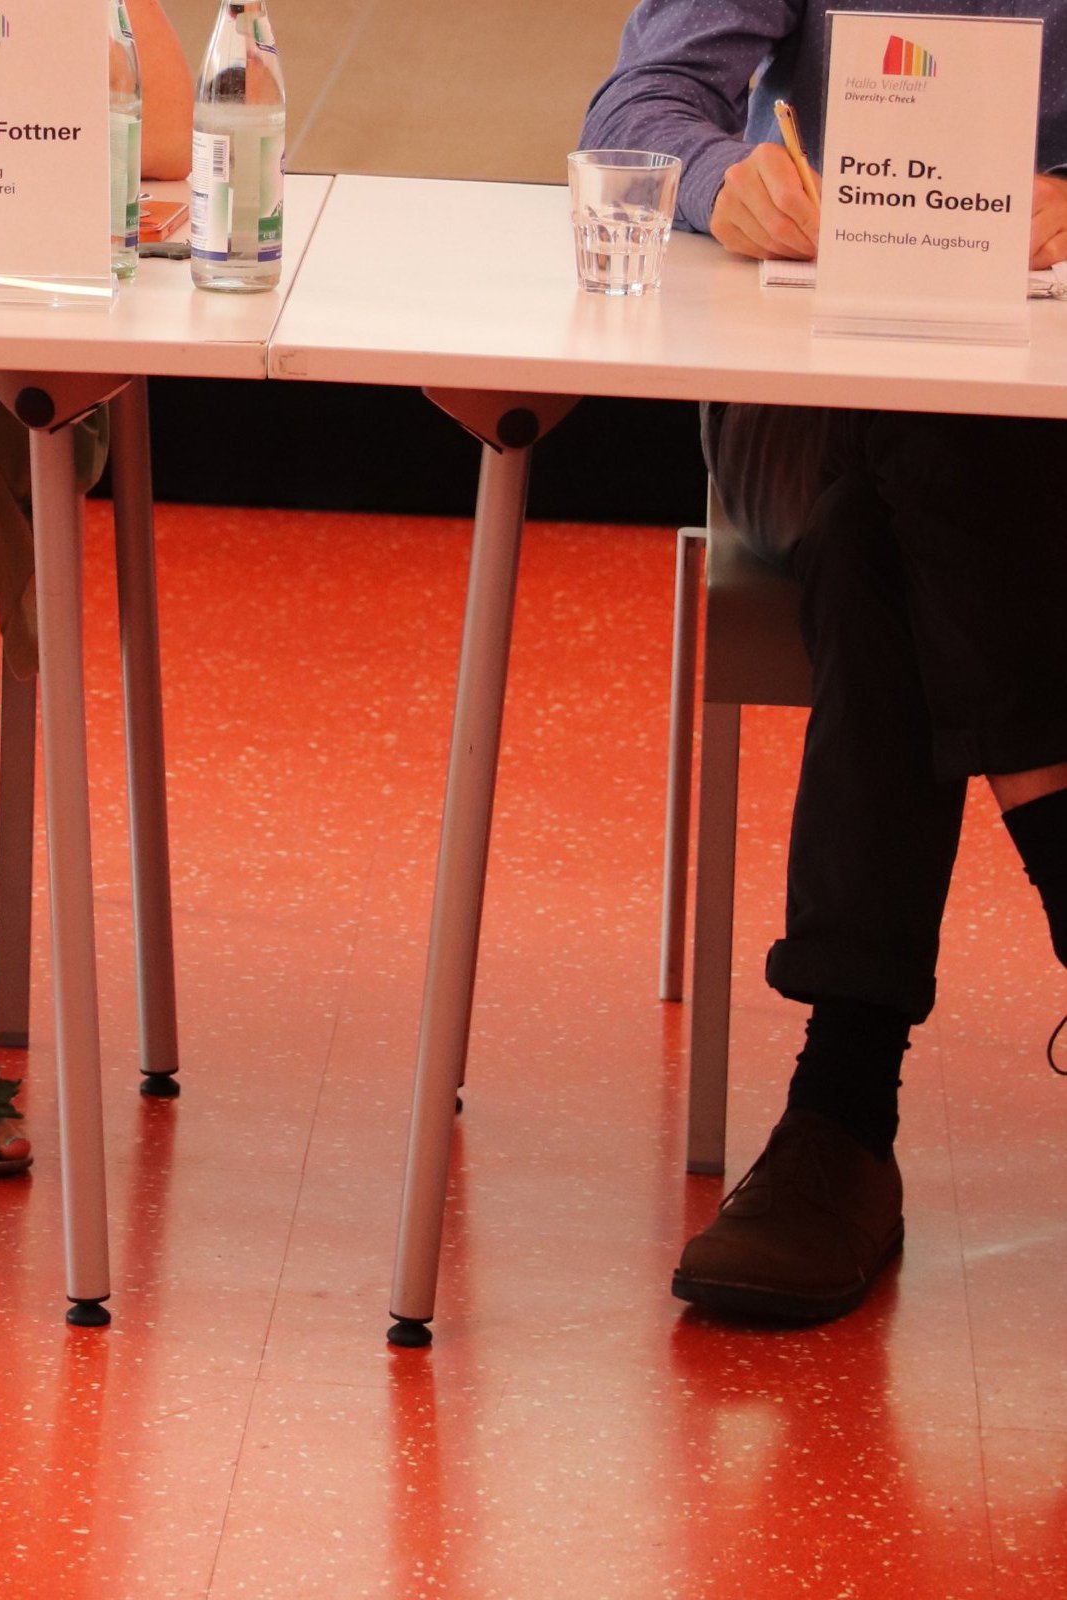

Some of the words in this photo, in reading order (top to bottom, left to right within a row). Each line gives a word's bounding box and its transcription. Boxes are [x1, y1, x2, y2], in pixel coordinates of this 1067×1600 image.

[845, 77, 877, 90] Hallo
[882, 78, 926, 92] Vielfalt!
[844, 92, 916, 104] Diversity-Check
[840, 155, 897, 178] Prof.
[908, 160, 942, 180] Dr.
[838, 185, 916, 208] Simon
[925, 190, 1011, 213] Goebel
[835, 229, 918, 246] Hochschule
[921, 234, 990, 251] Augsburg
